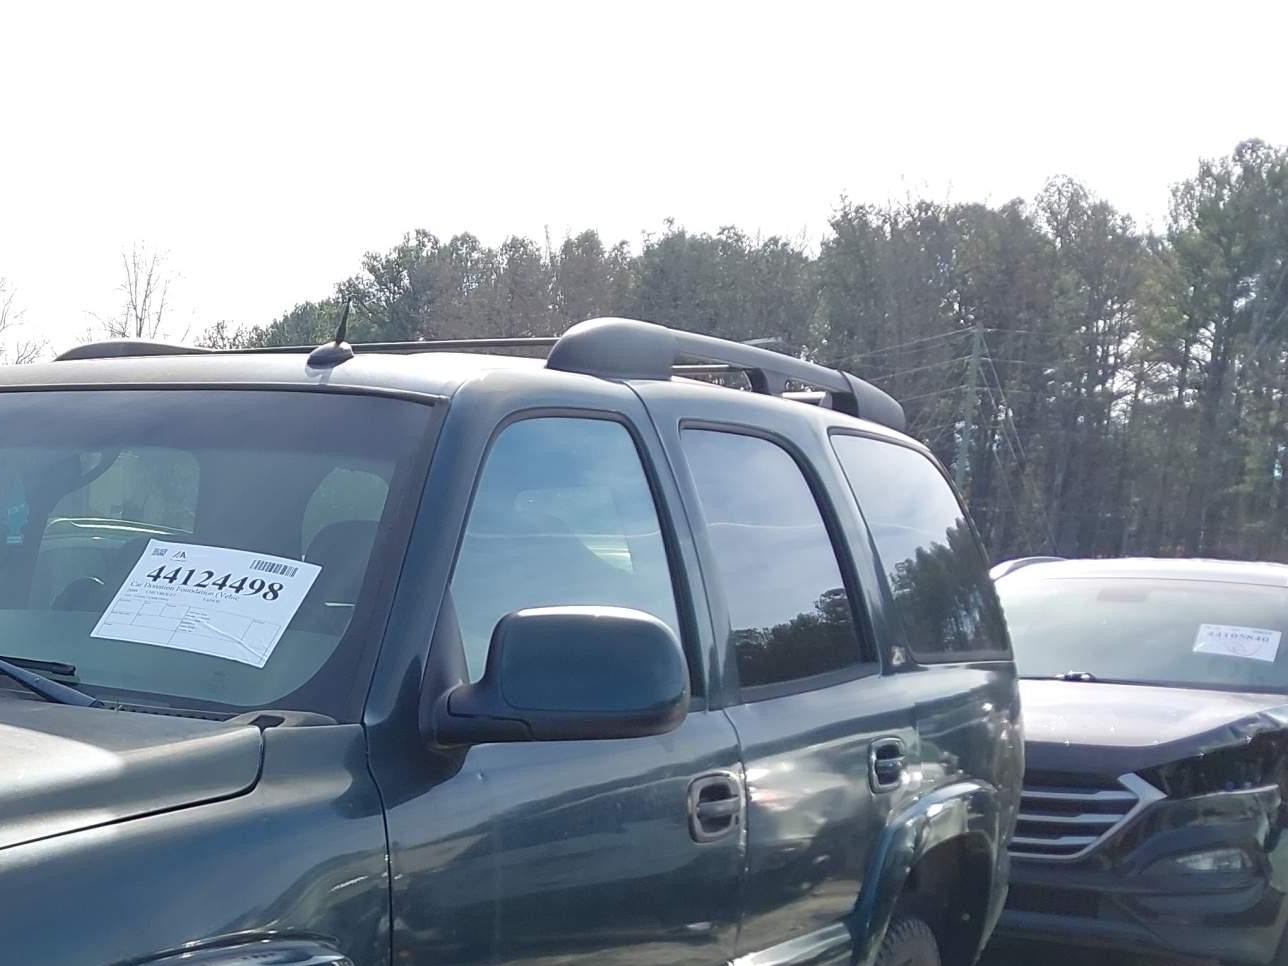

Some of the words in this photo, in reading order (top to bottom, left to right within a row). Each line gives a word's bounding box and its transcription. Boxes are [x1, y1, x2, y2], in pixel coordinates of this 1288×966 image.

[144, 581, 175, 593] Donation
[175, 584, 215, 598] Foundation
[146, 564, 284, 601] 44124498
